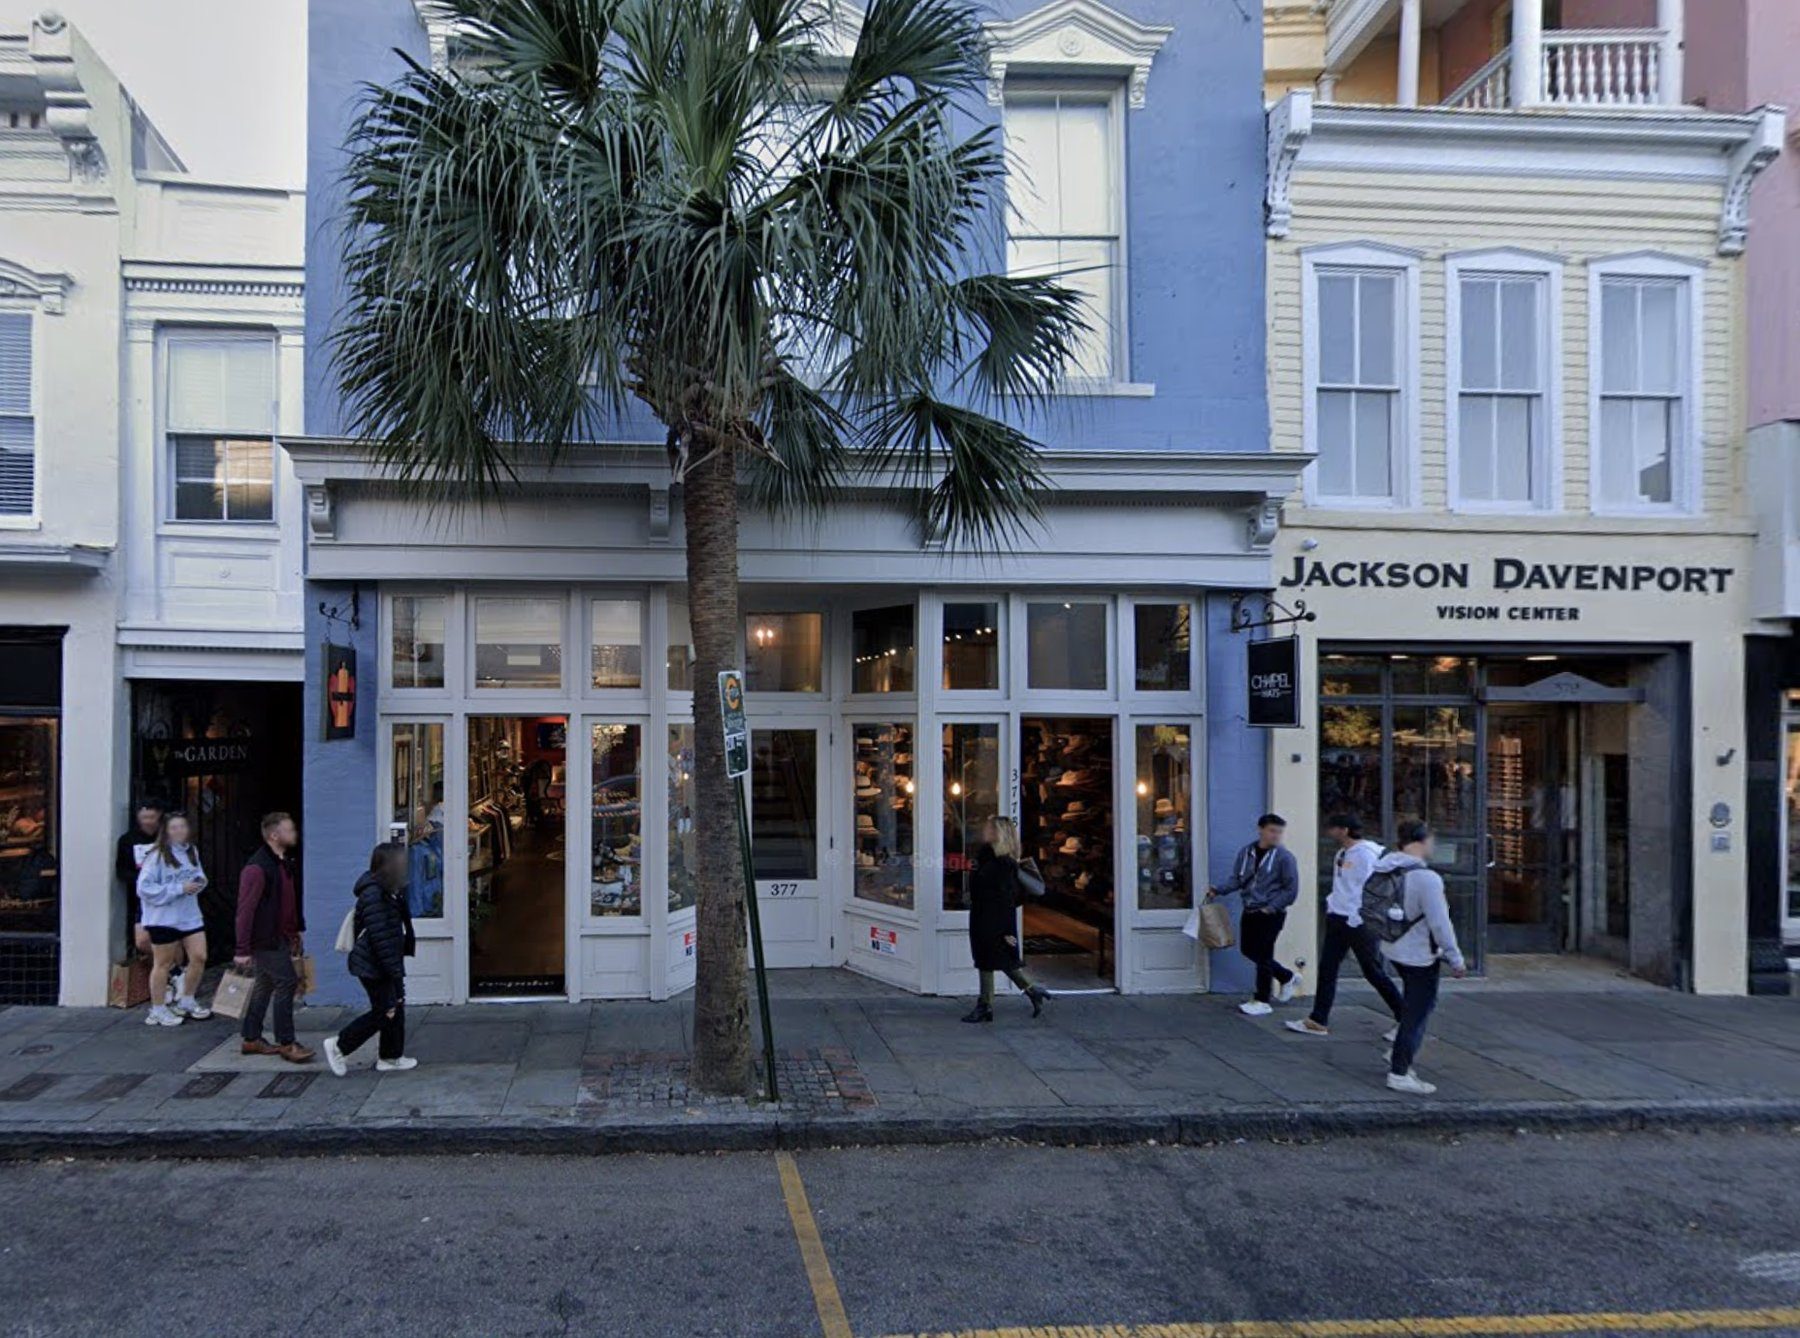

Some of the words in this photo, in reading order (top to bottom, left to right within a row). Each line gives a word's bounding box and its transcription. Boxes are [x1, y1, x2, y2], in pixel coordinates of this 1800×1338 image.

[1280, 556, 1468, 588] JACKSON
[1493, 558, 1734, 593] DAVENPORT
[1437, 605, 1499, 619] VISION
[1507, 606, 1580, 620] CENTER
[184, 745, 248, 762] GARDEN
[771, 883, 798, 896] 377
